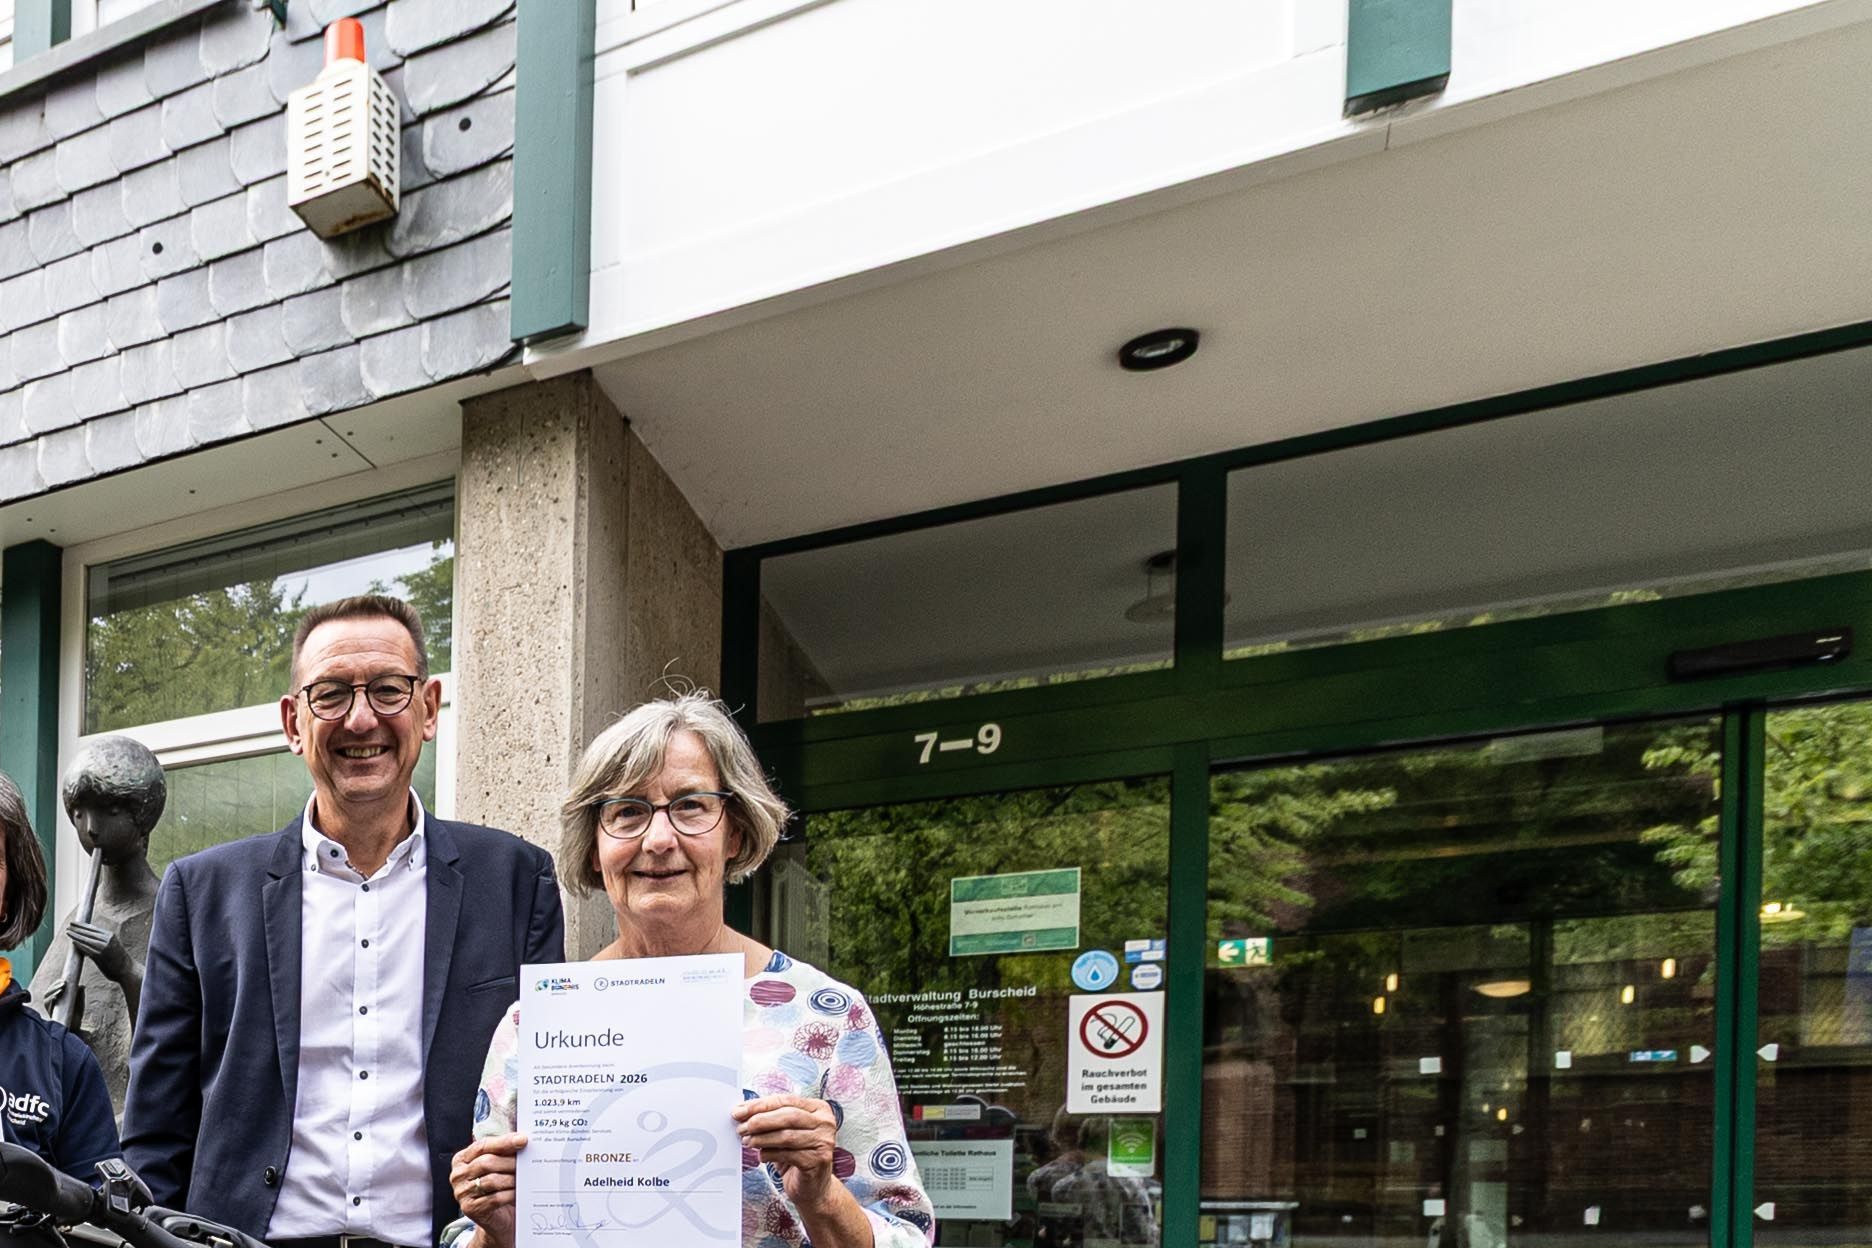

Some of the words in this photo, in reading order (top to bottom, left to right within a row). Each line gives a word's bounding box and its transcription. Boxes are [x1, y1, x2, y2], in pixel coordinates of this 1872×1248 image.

[610, 978, 666, 987] STADTRADELN
[968, 985, 1037, 1000] Burscheid
[913, 1002, 962, 1012] Höhestraße
[964, 1001, 979, 1009] 7-9
[893, 1028, 918, 1036] Montag
[534, 1028, 625, 1049] Urkunde
[943, 1040, 986, 1048] geschlossen
[893, 1056, 916, 1064] Freitag
[1081, 1068, 1148, 1078] Rauchverbot
[533, 1073, 615, 1085] STADTRADELN
[620, 1073, 648, 1084] 2026
[1081, 1082, 1096, 1091] im
[1096, 1082, 1148, 1094] gesamten
[534, 1098, 566, 1107] 1.023,9
[567, 1098, 581, 1106] km
[1090, 1094, 1137, 1104] Gebäude
[8, 1092, 50, 1118] adfc
[534, 1119, 558, 1128] 167,9
[559, 1118, 569, 1128] kg
[585, 1153, 632, 1163] BRONZE
[583, 1176, 634, 1187] Adelheid
[637, 1176, 670, 1187] Kolbe
